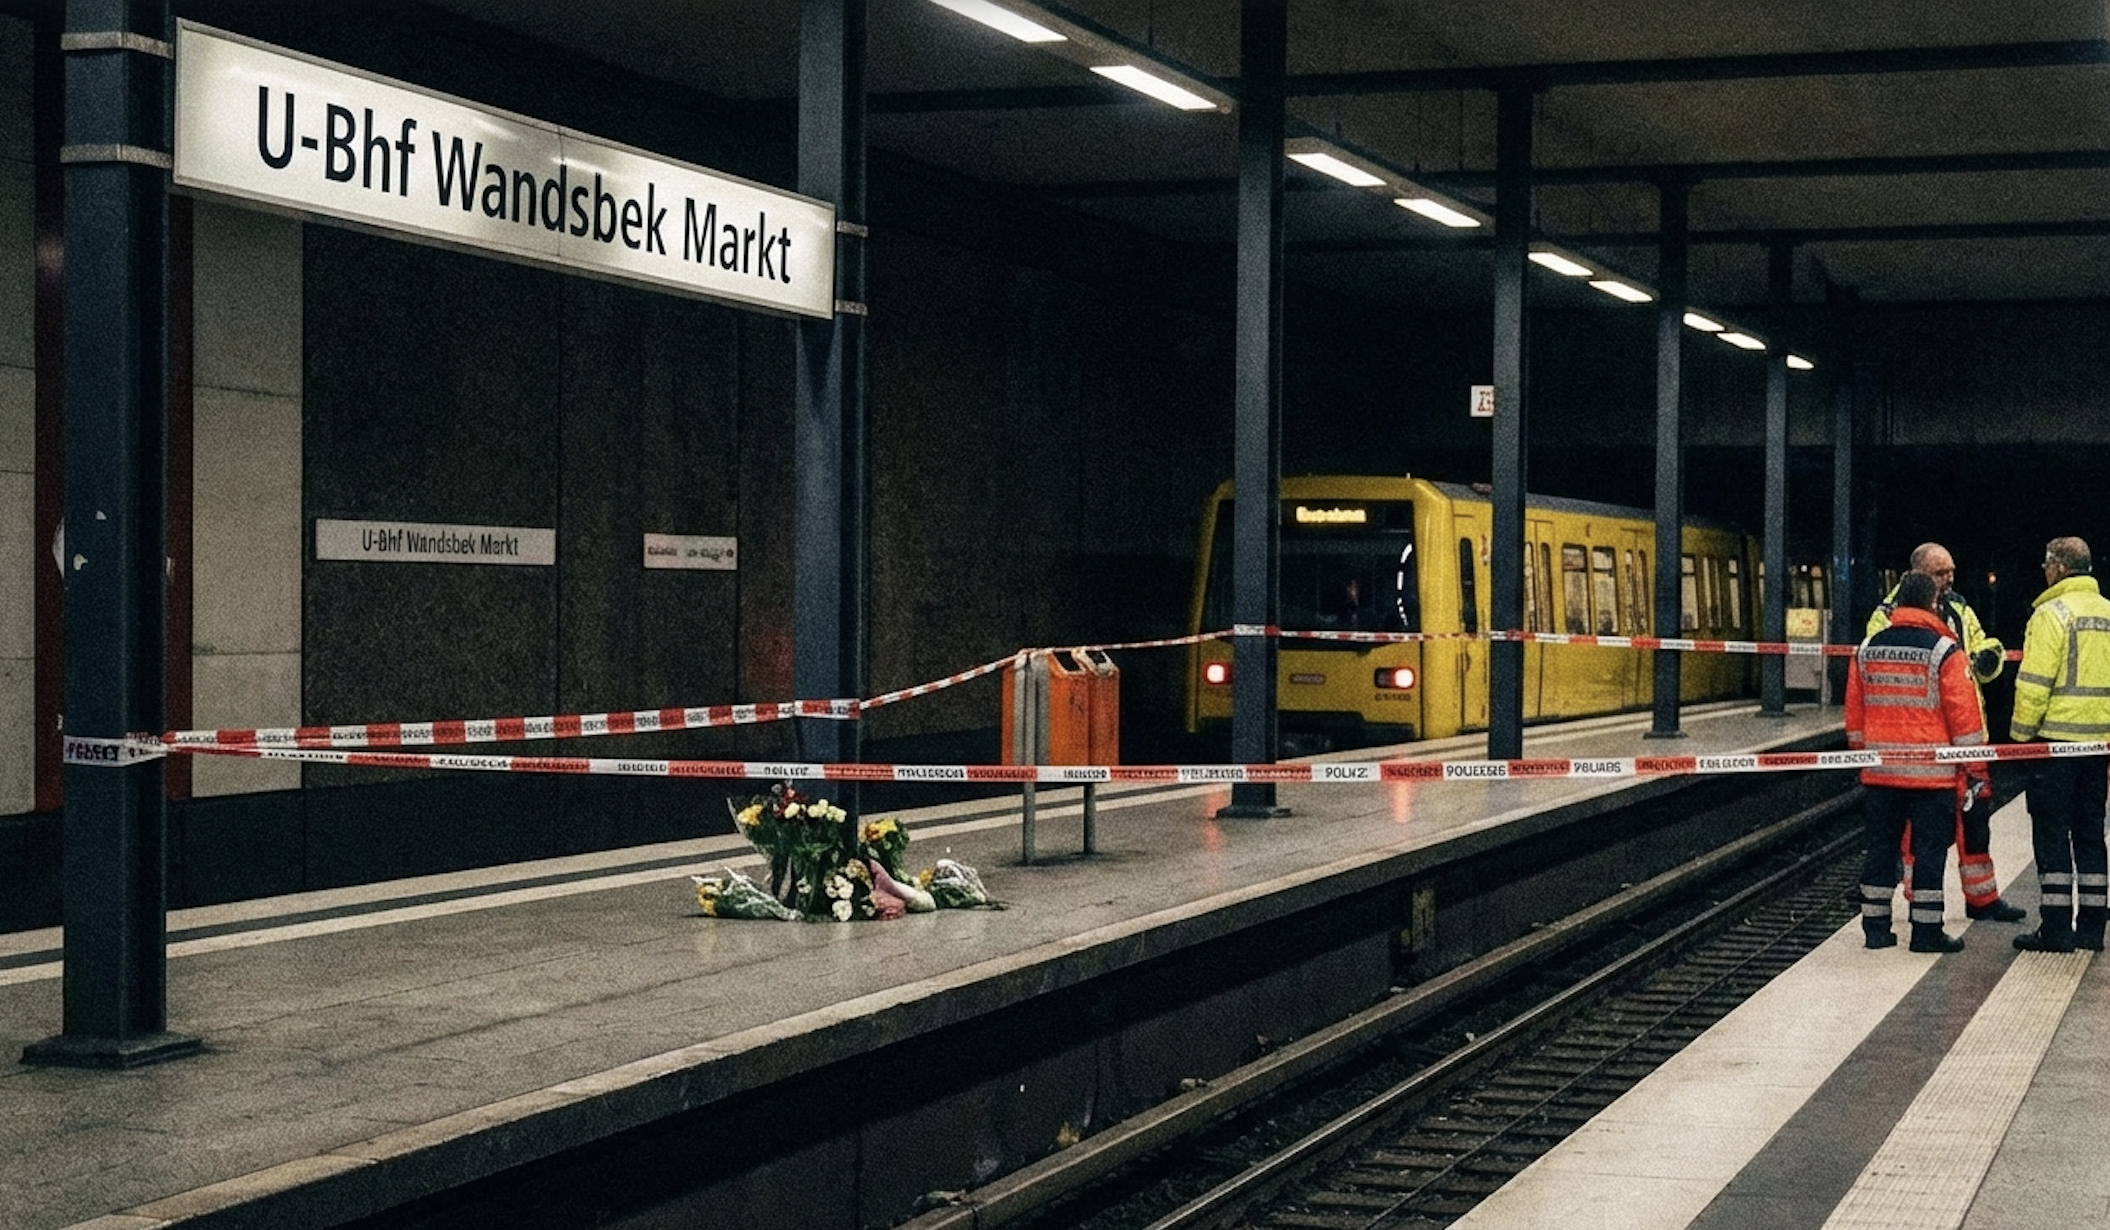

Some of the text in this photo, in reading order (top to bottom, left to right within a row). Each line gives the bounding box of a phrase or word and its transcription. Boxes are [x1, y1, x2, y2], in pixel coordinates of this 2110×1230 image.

[258, 84, 791, 285] U-Bhf Wandsbek Markt
